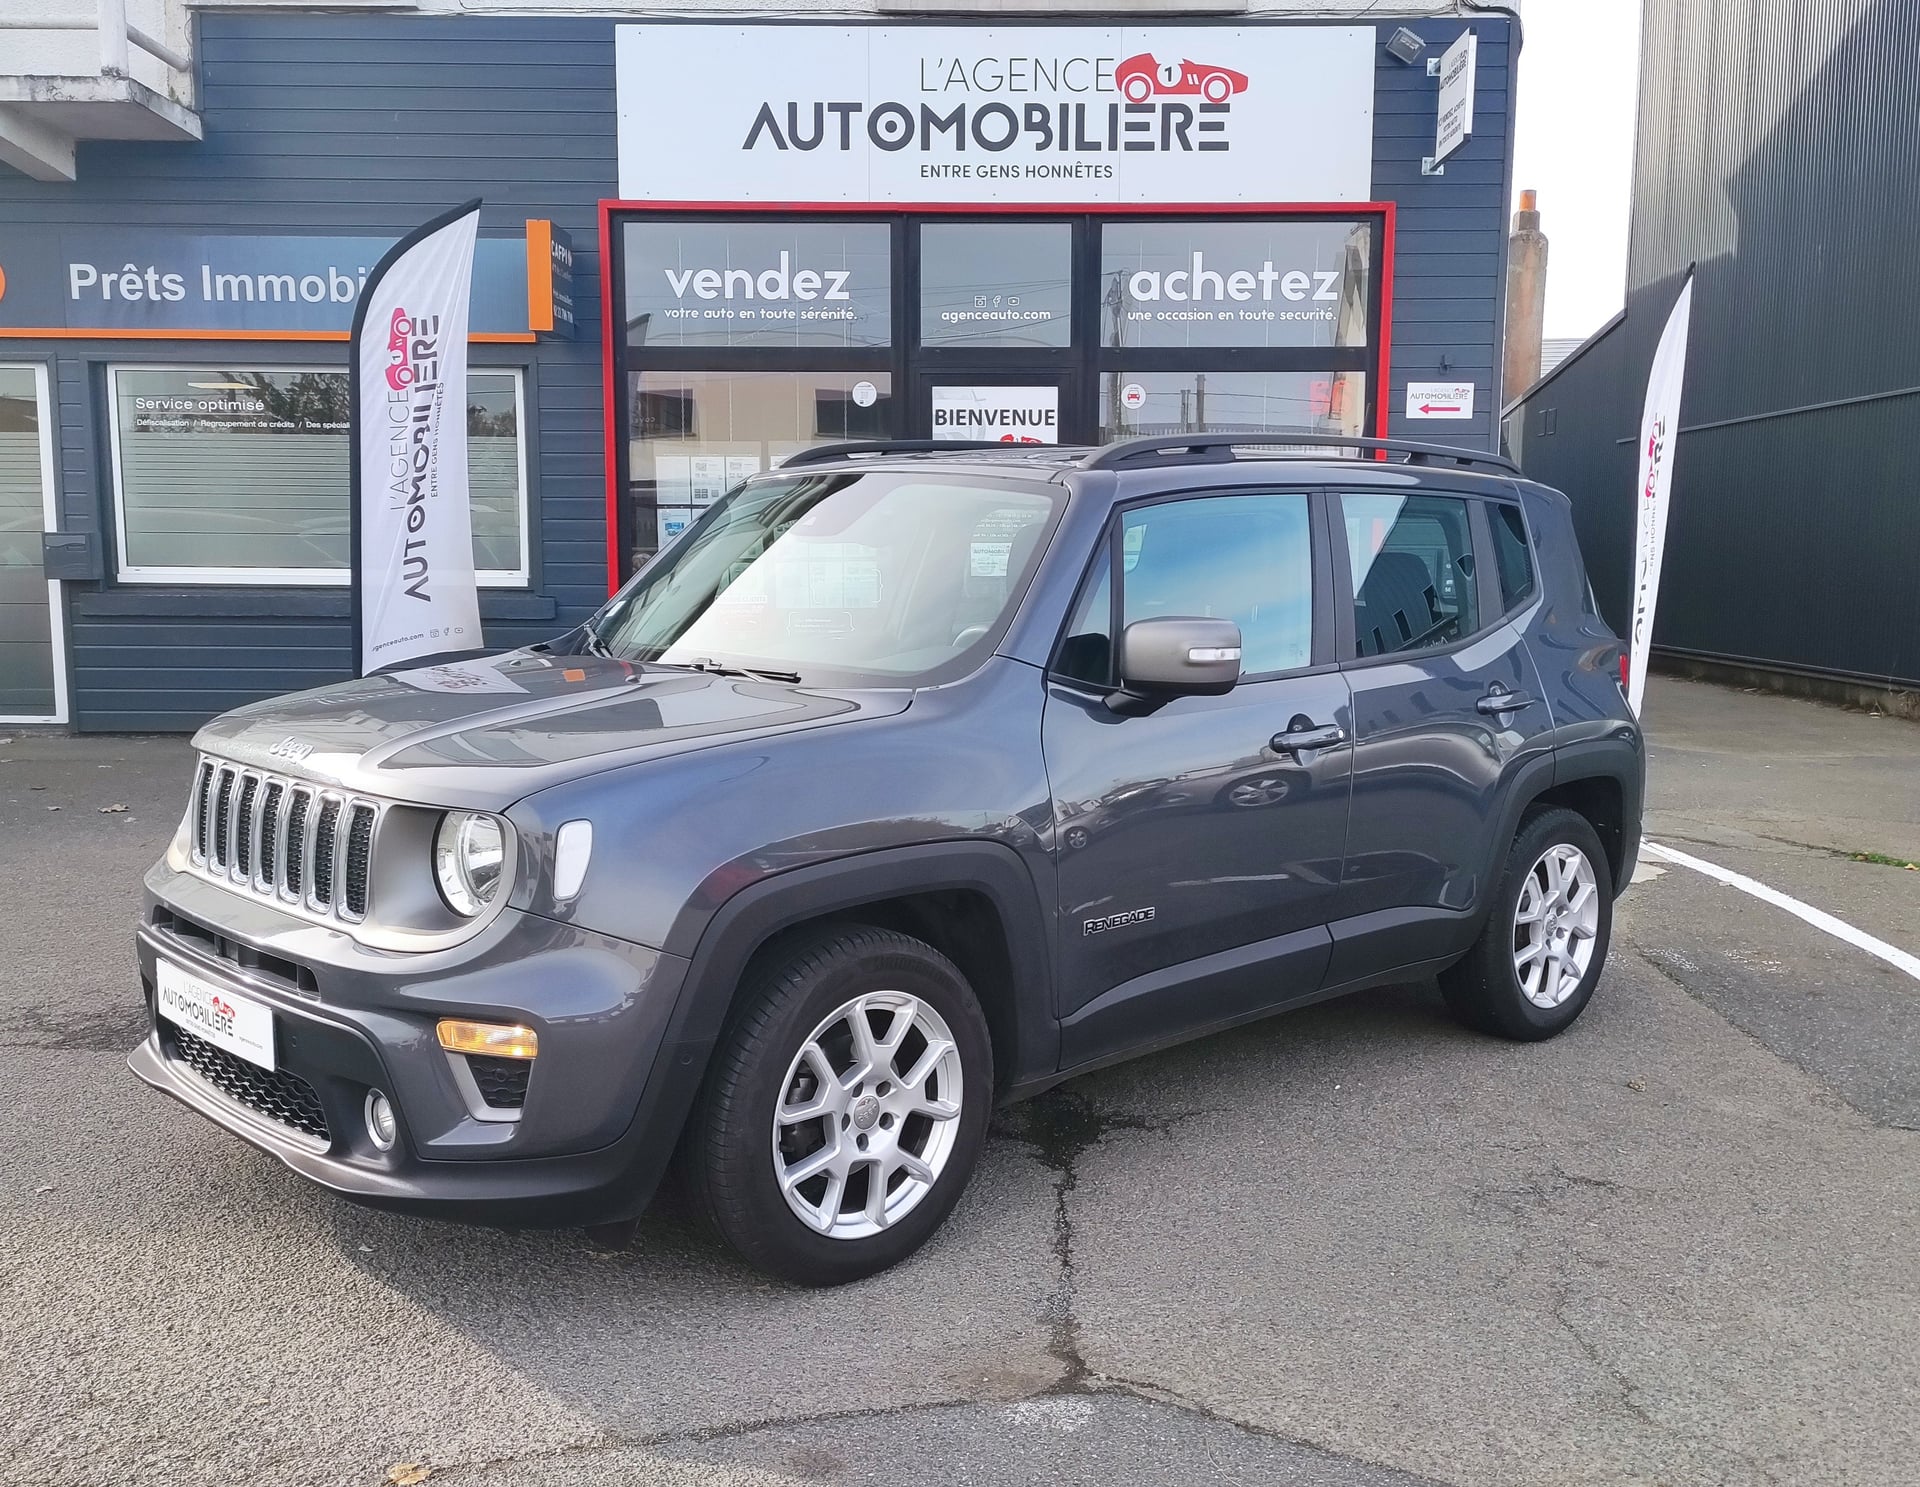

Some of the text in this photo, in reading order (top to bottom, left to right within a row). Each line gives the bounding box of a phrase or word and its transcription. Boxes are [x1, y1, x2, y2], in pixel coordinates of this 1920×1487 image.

[920, 57, 1115, 92] L'AGENCE
[742, 101, 1231, 151] AUTOMOBILIERE
[920, 160, 1114, 178] ENTRE GENS HONNÊTES
[69, 263, 375, 303] Prêts Immobi
[664, 250, 851, 300] vendez
[1128, 251, 1340, 301] achetez
[664, 306, 857, 320] votre auto en toute sérénité.
[941, 309, 1051, 324] agenceauto.com
[1127, 311, 1152, 321] une
[1156, 308, 1214, 321] occasion
[1218, 311, 1234, 320] en
[1239, 308, 1275, 321] toute
[135, 398, 265, 413] Service optimisé
[934, 409, 1056, 427] BIENVENUE
[136, 419, 190, 427] Défiscalisation
[200, 420, 256, 429] Regroupement
[269, 420, 295, 428] crédits
[431, 438, 439, 465] GENS
[430, 466, 438, 498] ENTRE
[1083, 906, 1156, 937] RENEGADE
[162, 986, 235, 1038] AUTOMOBILIERE
